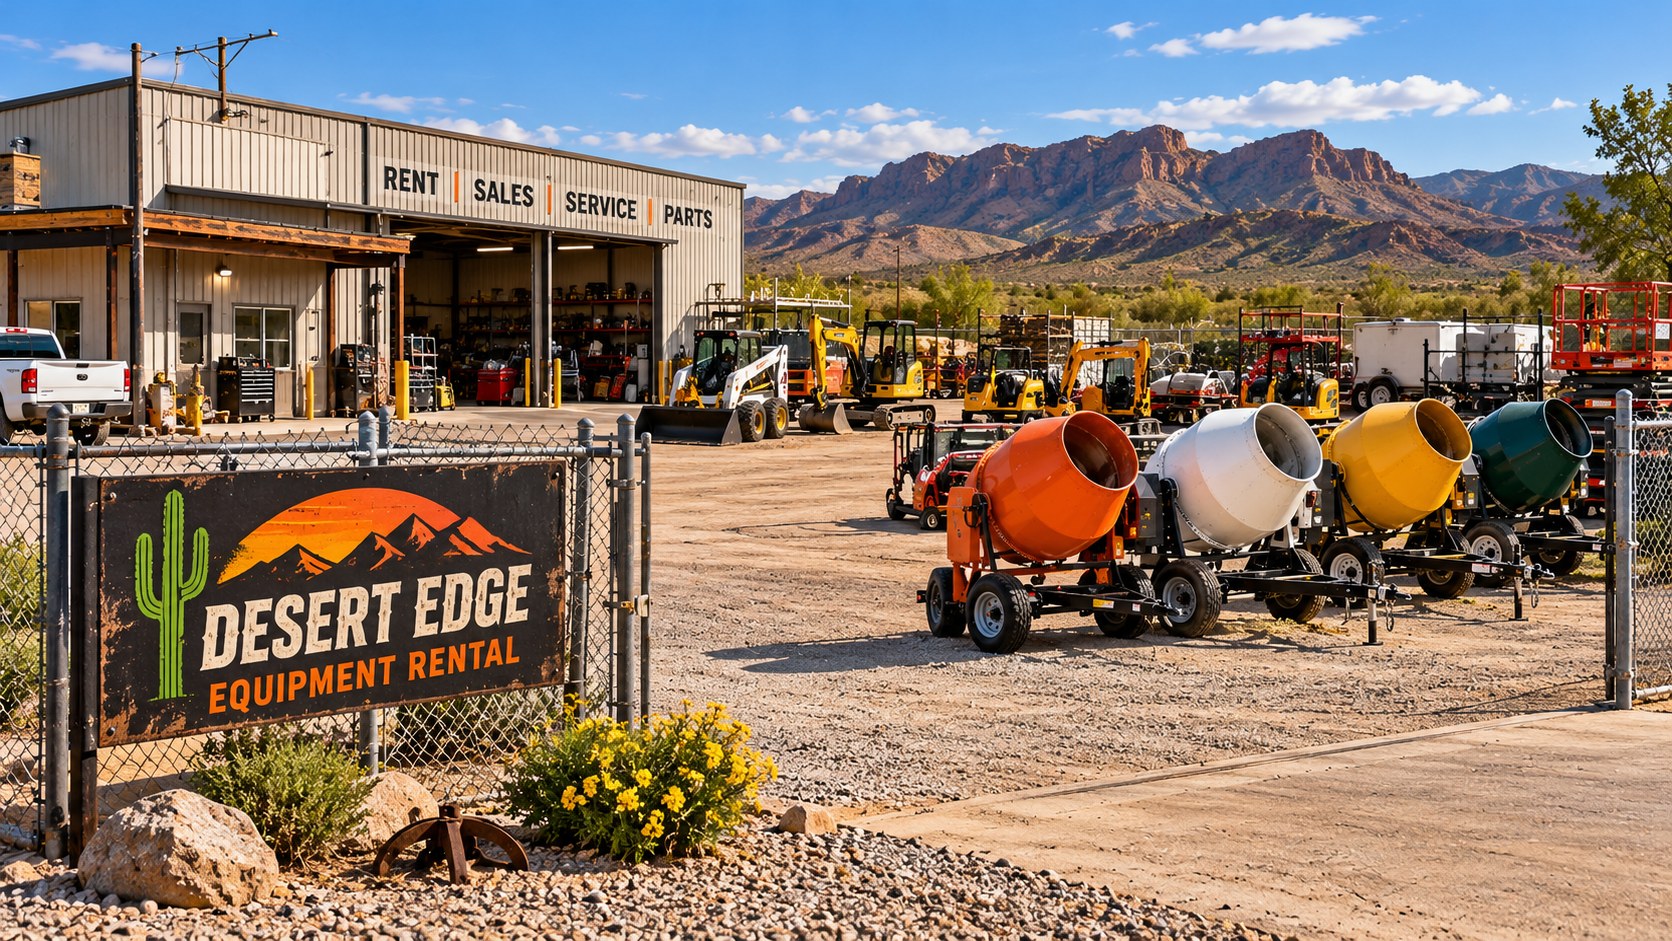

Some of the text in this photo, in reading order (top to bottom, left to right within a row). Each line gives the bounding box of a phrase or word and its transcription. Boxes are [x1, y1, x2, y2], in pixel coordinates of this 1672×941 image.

[384, 166, 713, 229] RENT SALES SERVICE PARTS
[200, 563, 533, 671] DESERT EDGE
[208, 636, 520, 714] EQUIPMENT RENTAL
